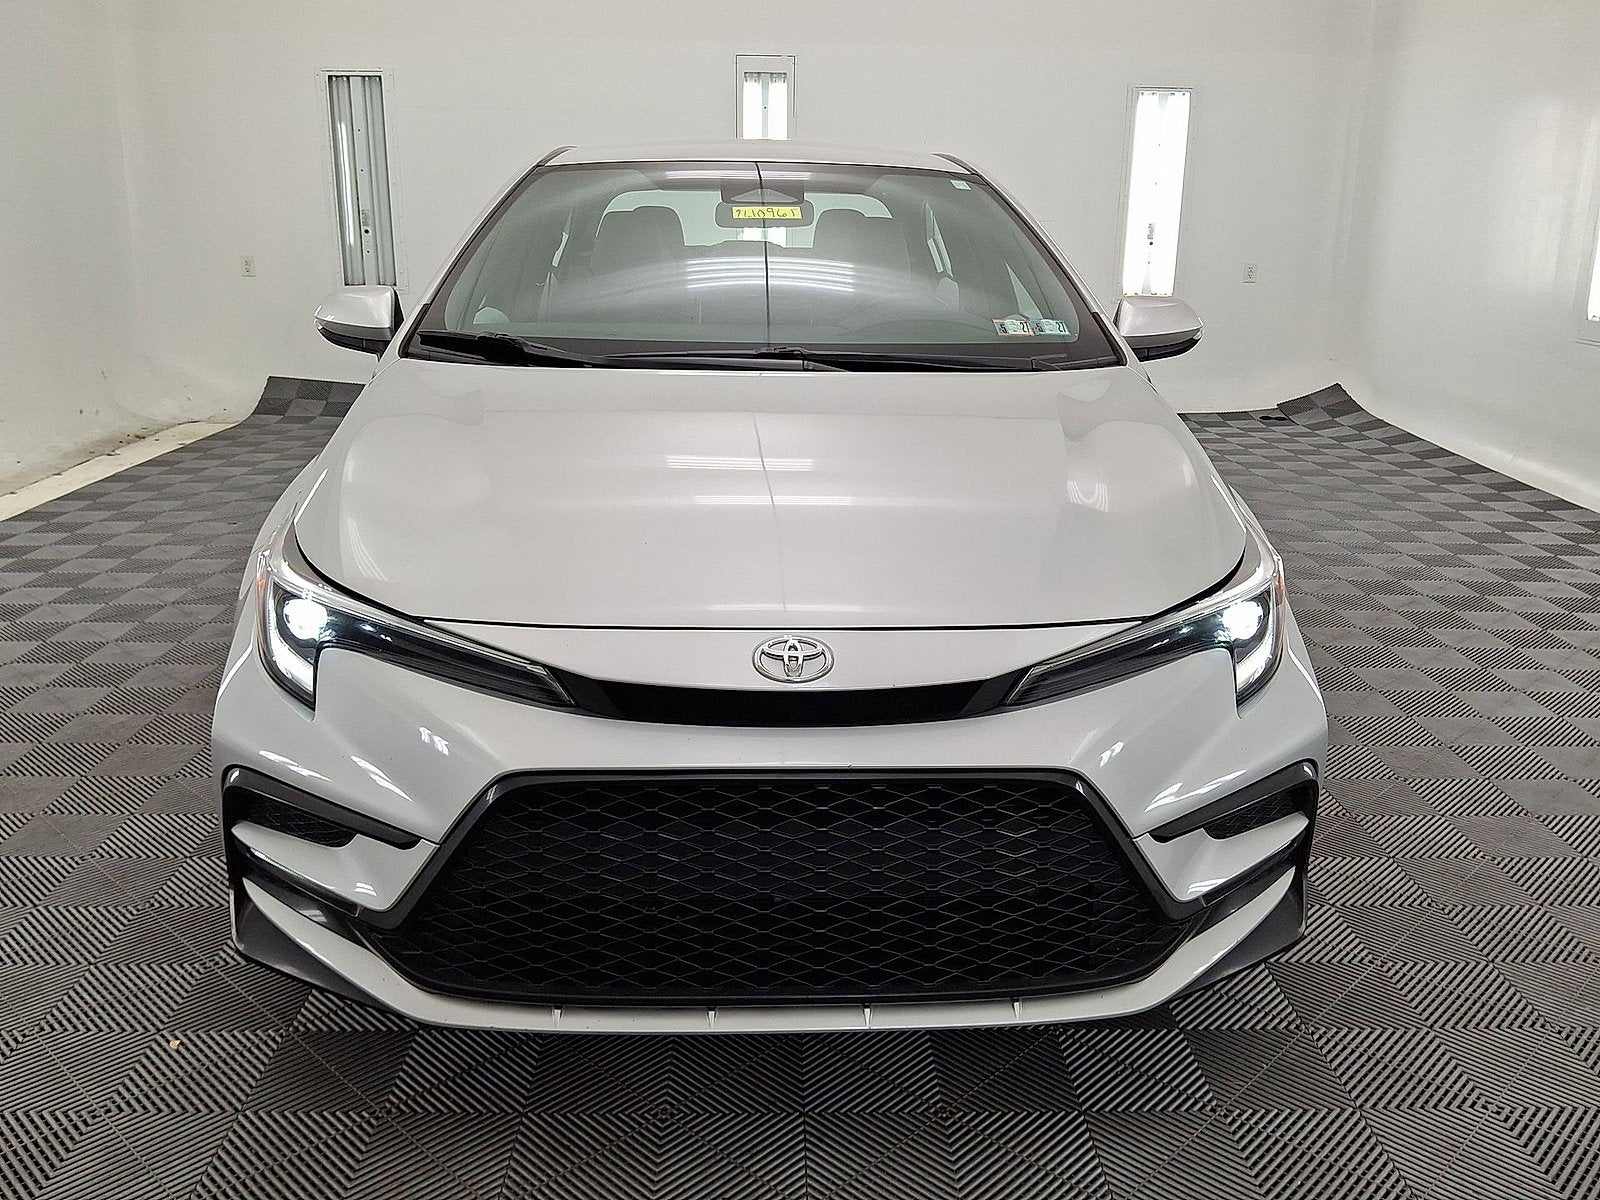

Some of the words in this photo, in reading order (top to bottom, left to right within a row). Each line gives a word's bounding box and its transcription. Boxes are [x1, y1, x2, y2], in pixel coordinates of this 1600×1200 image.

[999, 323, 1008, 334] 5
[1019, 321, 1031, 333] 27
[1055, 321, 1067, 333] 27
